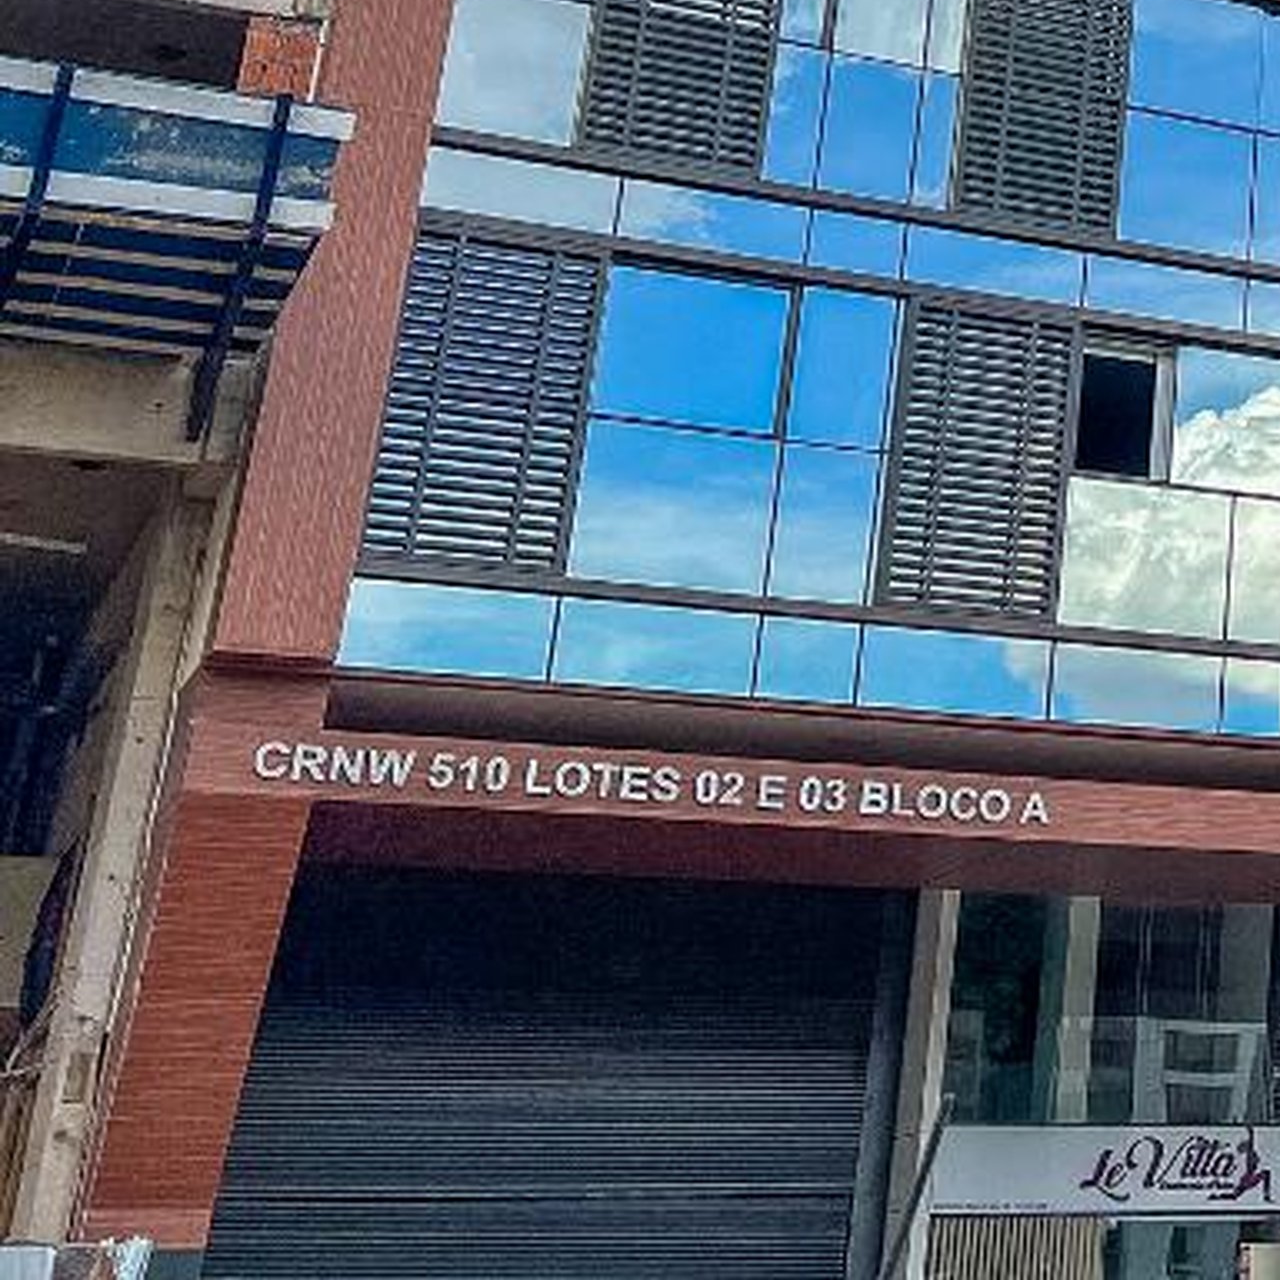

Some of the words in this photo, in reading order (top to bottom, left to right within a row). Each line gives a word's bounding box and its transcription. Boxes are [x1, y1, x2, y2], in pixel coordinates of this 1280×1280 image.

[254, 741, 416, 787] CRNW
[428, 753, 510, 792] 510
[525, 758, 681, 801] LOTES
[696, 770, 744, 805] 02
[757, 775, 788, 808] E
[800, 777, 847, 811] 03
[859, 780, 1011, 821] BLOCO
[1019, 792, 1049, 824] A
[1080, 1149, 1131, 1201] Le
